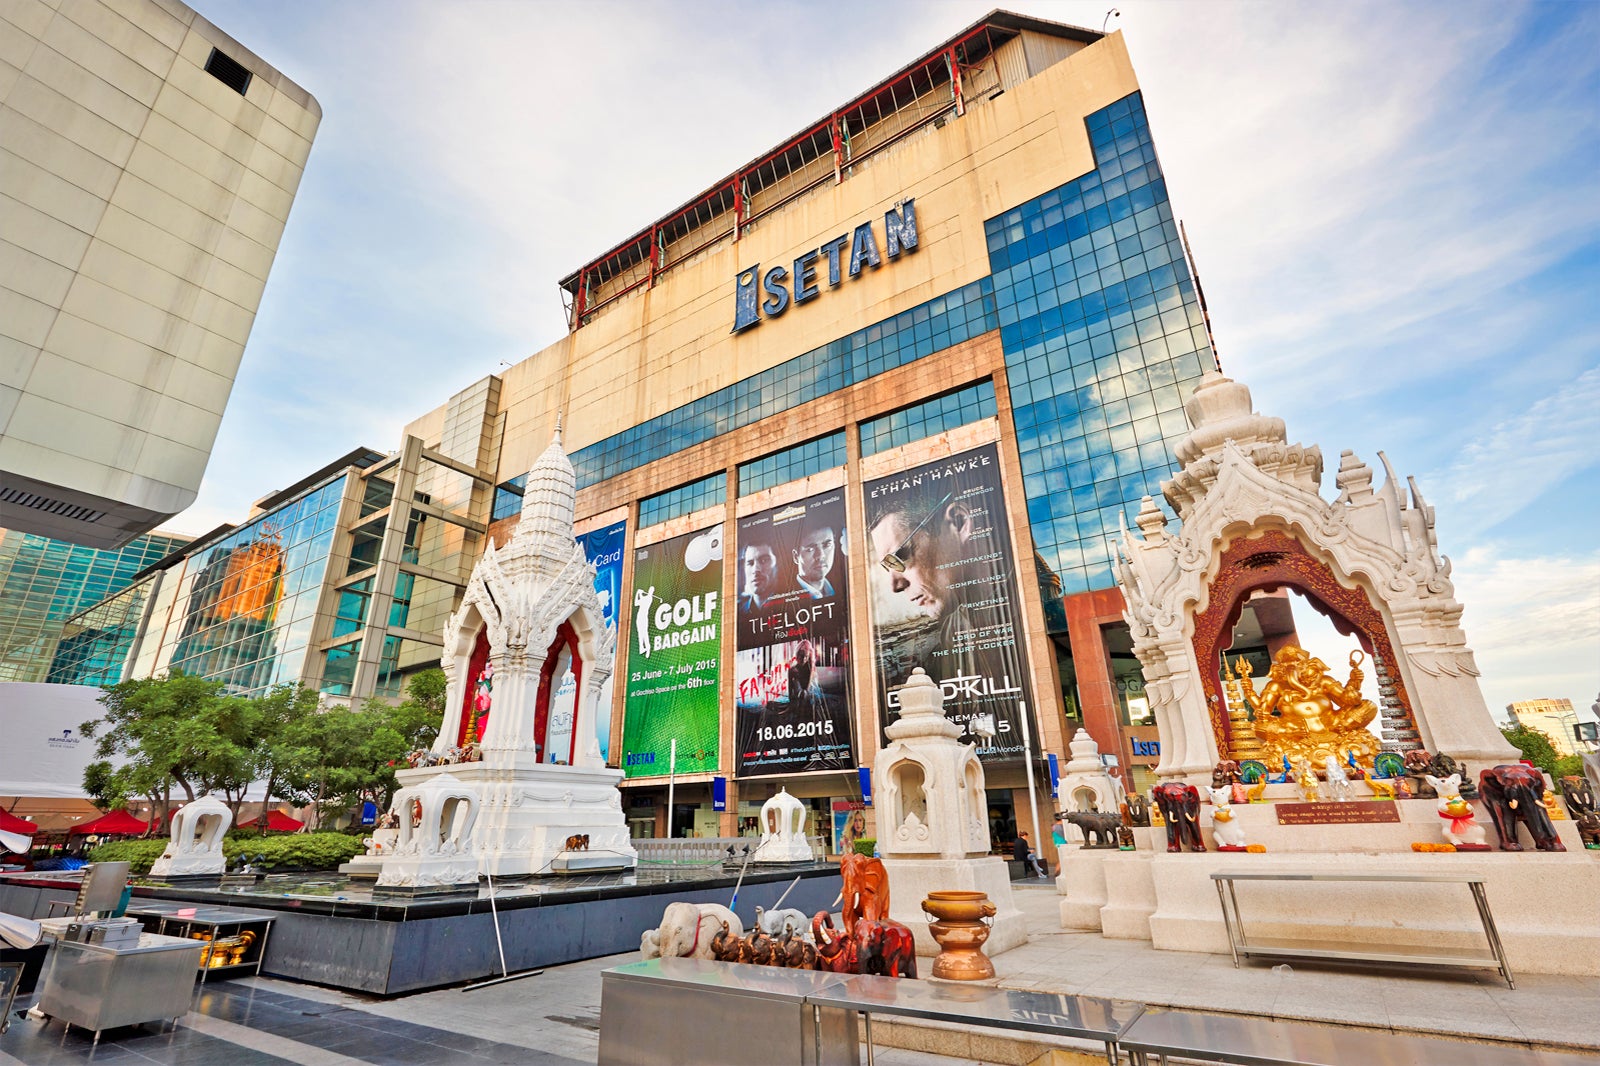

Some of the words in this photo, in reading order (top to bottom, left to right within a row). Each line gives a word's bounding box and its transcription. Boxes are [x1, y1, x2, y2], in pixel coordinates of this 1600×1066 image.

[871, 477, 922, 498] ETHAN
[931, 456, 991, 481] HAWKE
[963, 485, 984, 494] BRUCE
[595, 548, 621, 567] Card
[654, 591, 718, 631] GOLF
[653, 624, 717, 652] BARGAIN
[952, 632, 976, 642] LORD
[979, 630, 991, 638] OF
[993, 626, 1013, 635] WAR
[932, 649, 949, 658] THE
[952, 645, 976, 655] HURT
[978, 639, 1015, 650] LOCKER
[631, 671, 641, 682] 25
[642, 670, 662, 681] June
[669, 665, 674, 675] 7
[676, 663, 693, 675] July
[695, 658, 716, 671] 2015
[687, 676, 703, 689] 6th
[964, 675, 1021, 699] KILL
[756, 719, 834, 741] 18.06.2015
